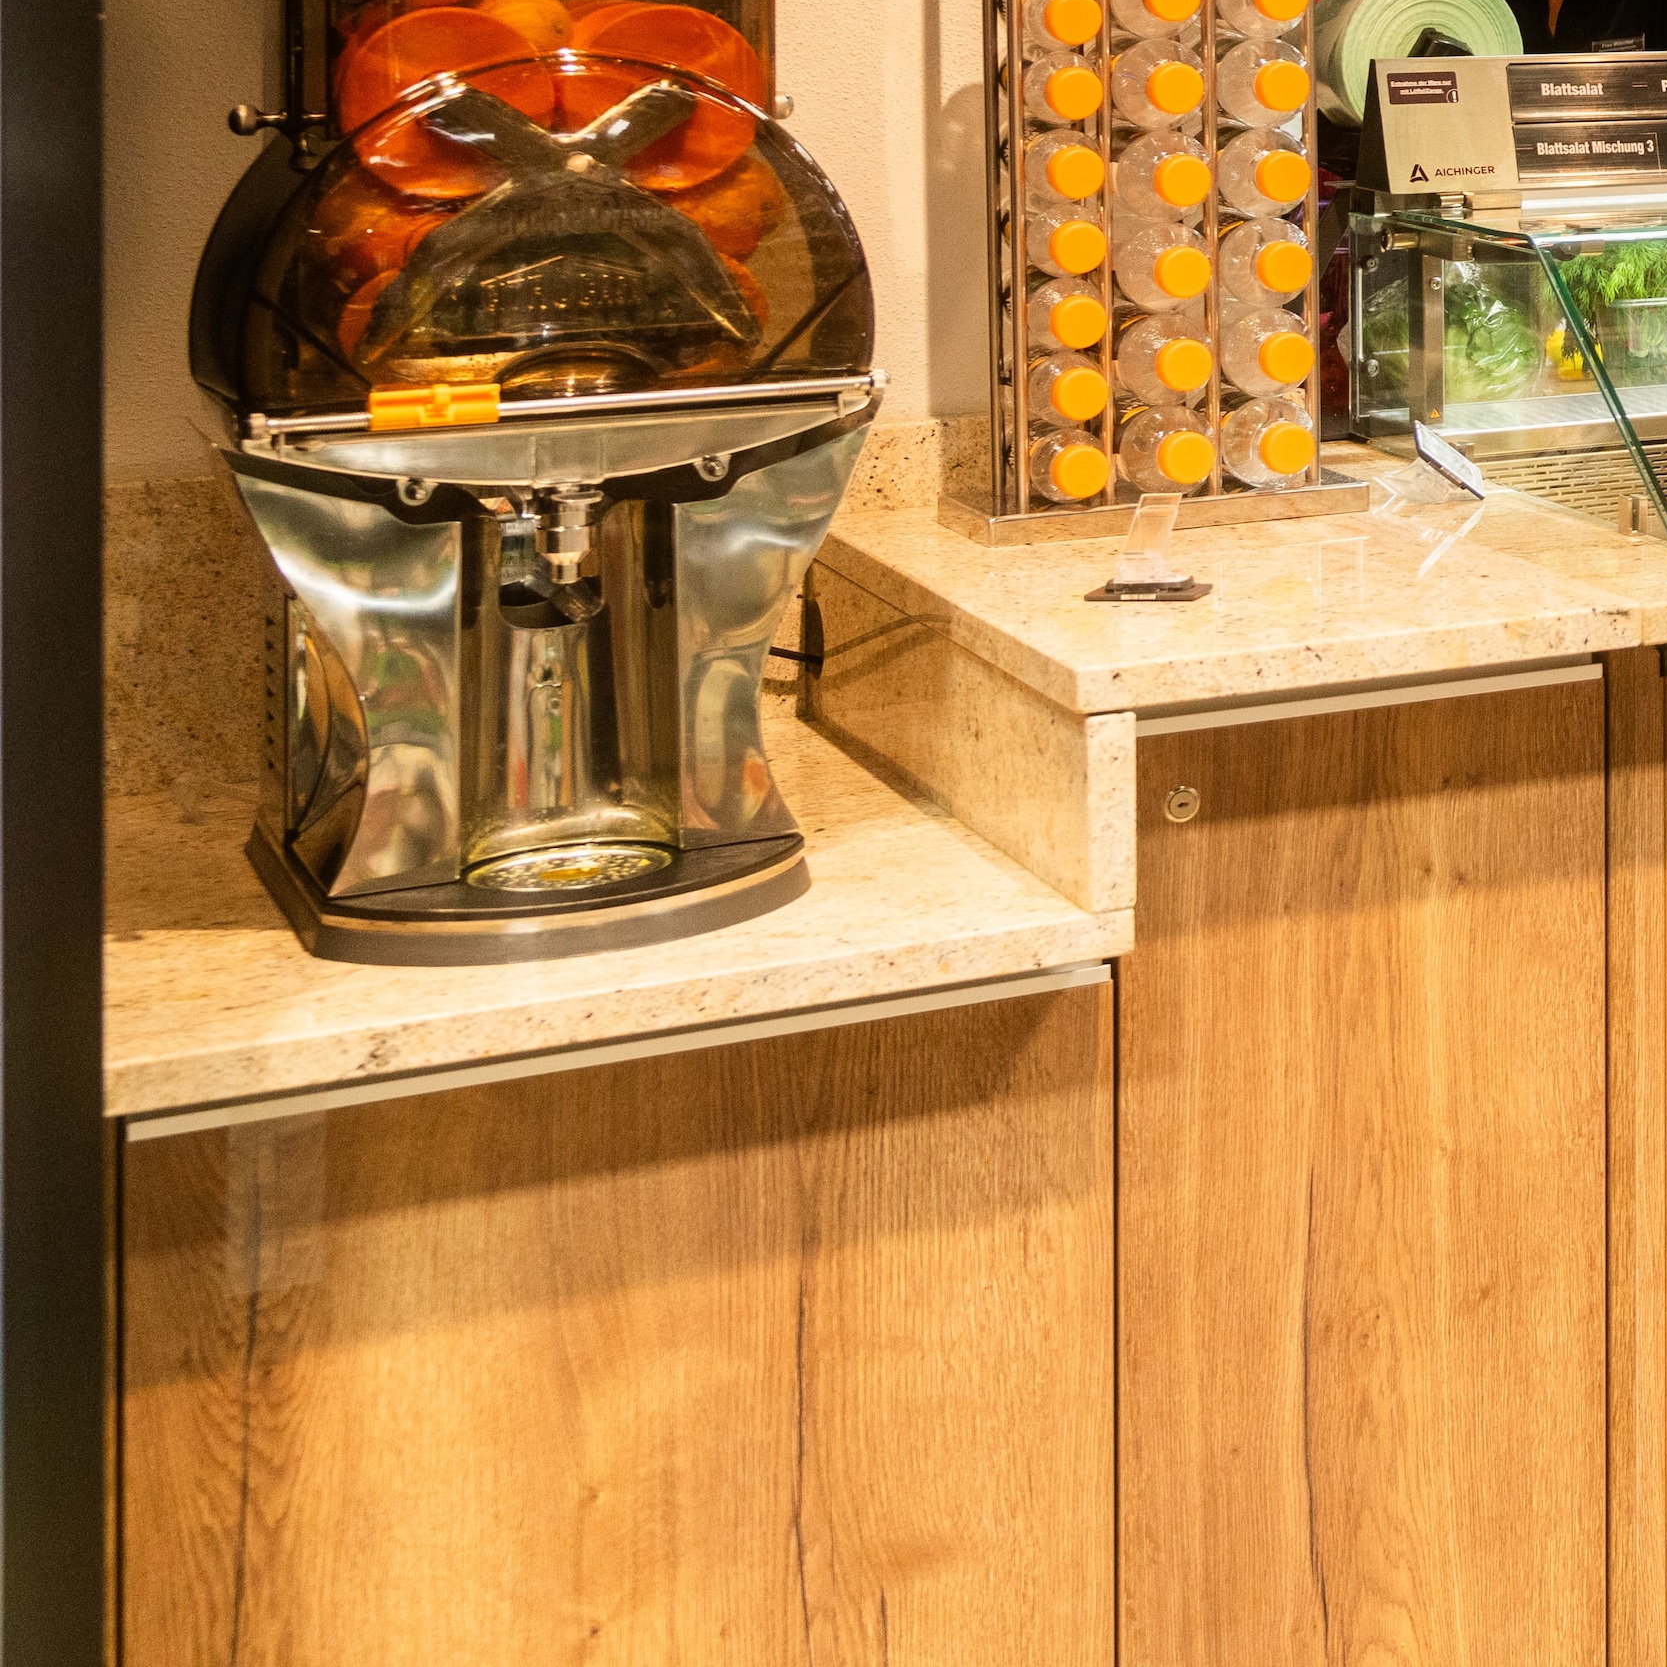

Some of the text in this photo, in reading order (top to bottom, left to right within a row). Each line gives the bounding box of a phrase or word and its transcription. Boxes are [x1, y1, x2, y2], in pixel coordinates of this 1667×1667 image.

[1541, 83, 1604, 96] Blattsalat
[1537, 139, 1655, 156] Blattsalat Mischung 3
[1434, 165, 1496, 178] AICHINGER
